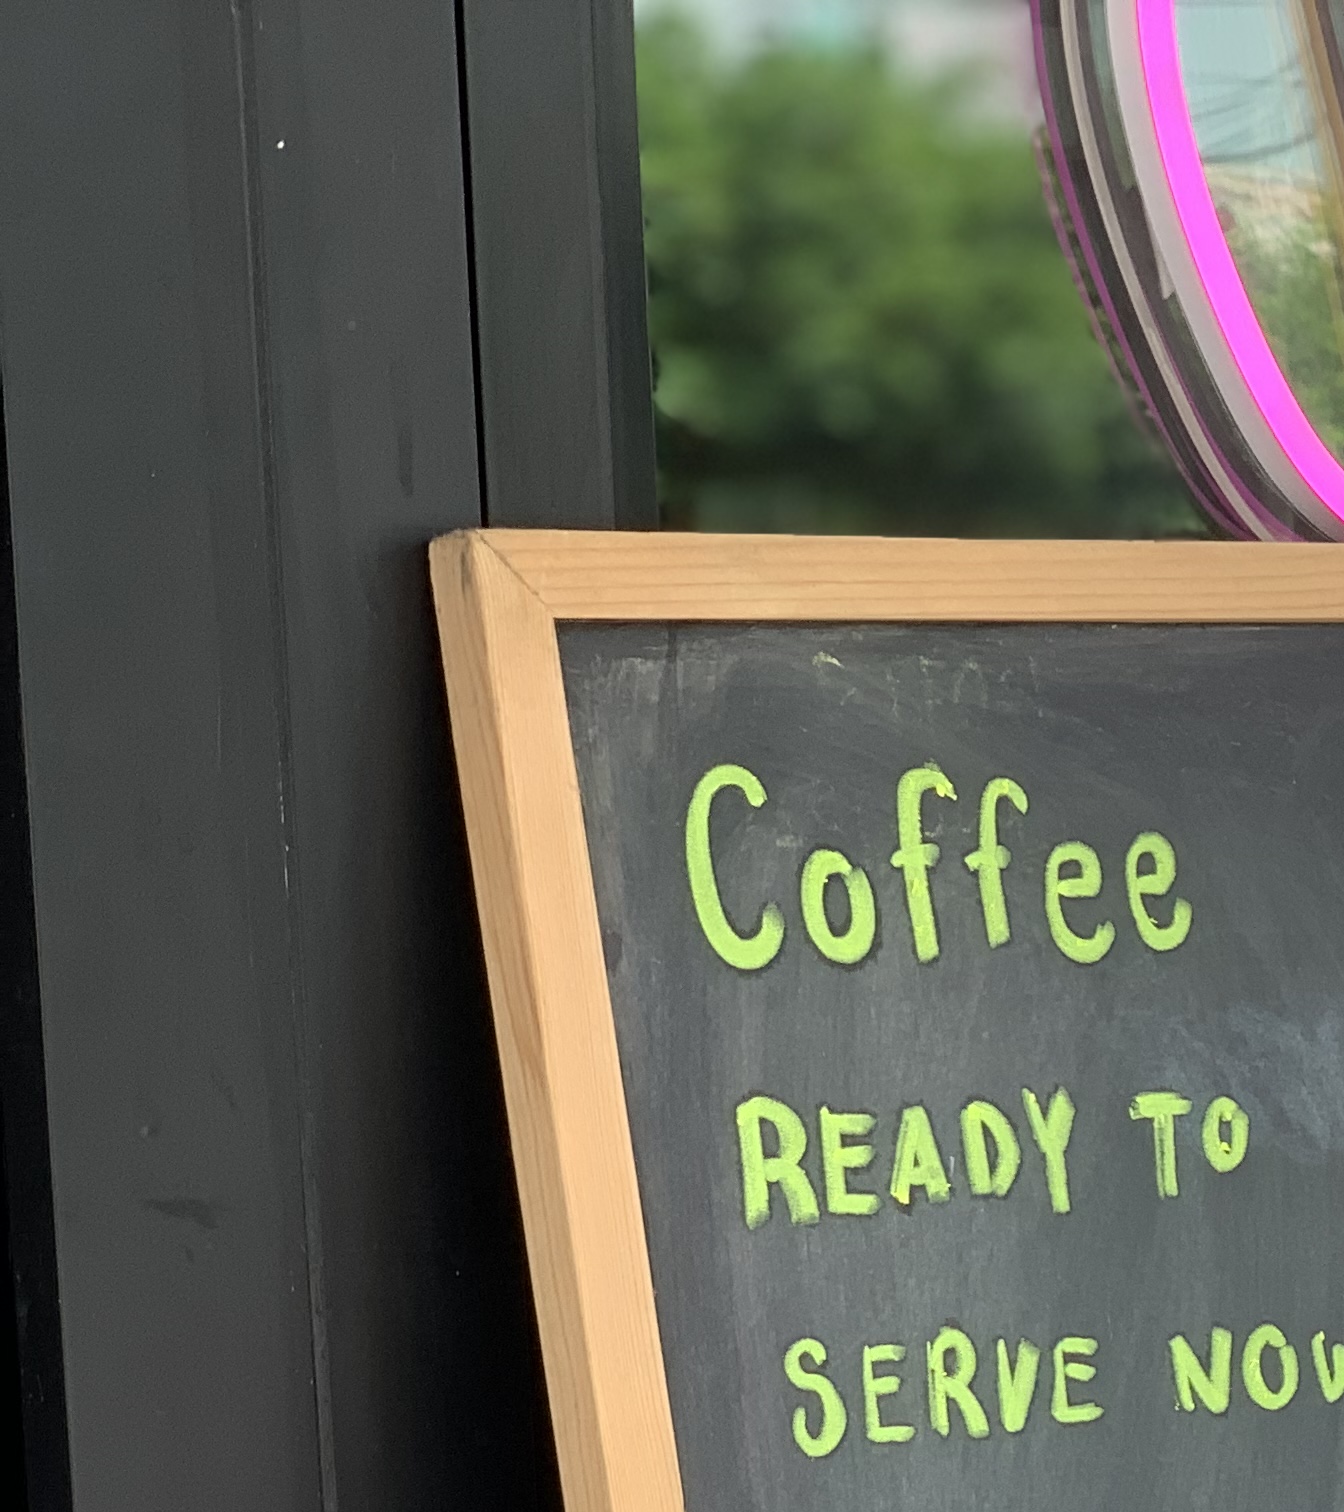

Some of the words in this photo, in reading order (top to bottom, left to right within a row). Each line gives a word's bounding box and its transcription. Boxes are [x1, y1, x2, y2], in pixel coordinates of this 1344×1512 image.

[685, 764, 1193, 970] Coffee
[736, 1088, 1074, 1228] READY
[1129, 1092, 1249, 1198] TO
[784, 1327, 1102, 1457] SERVE
